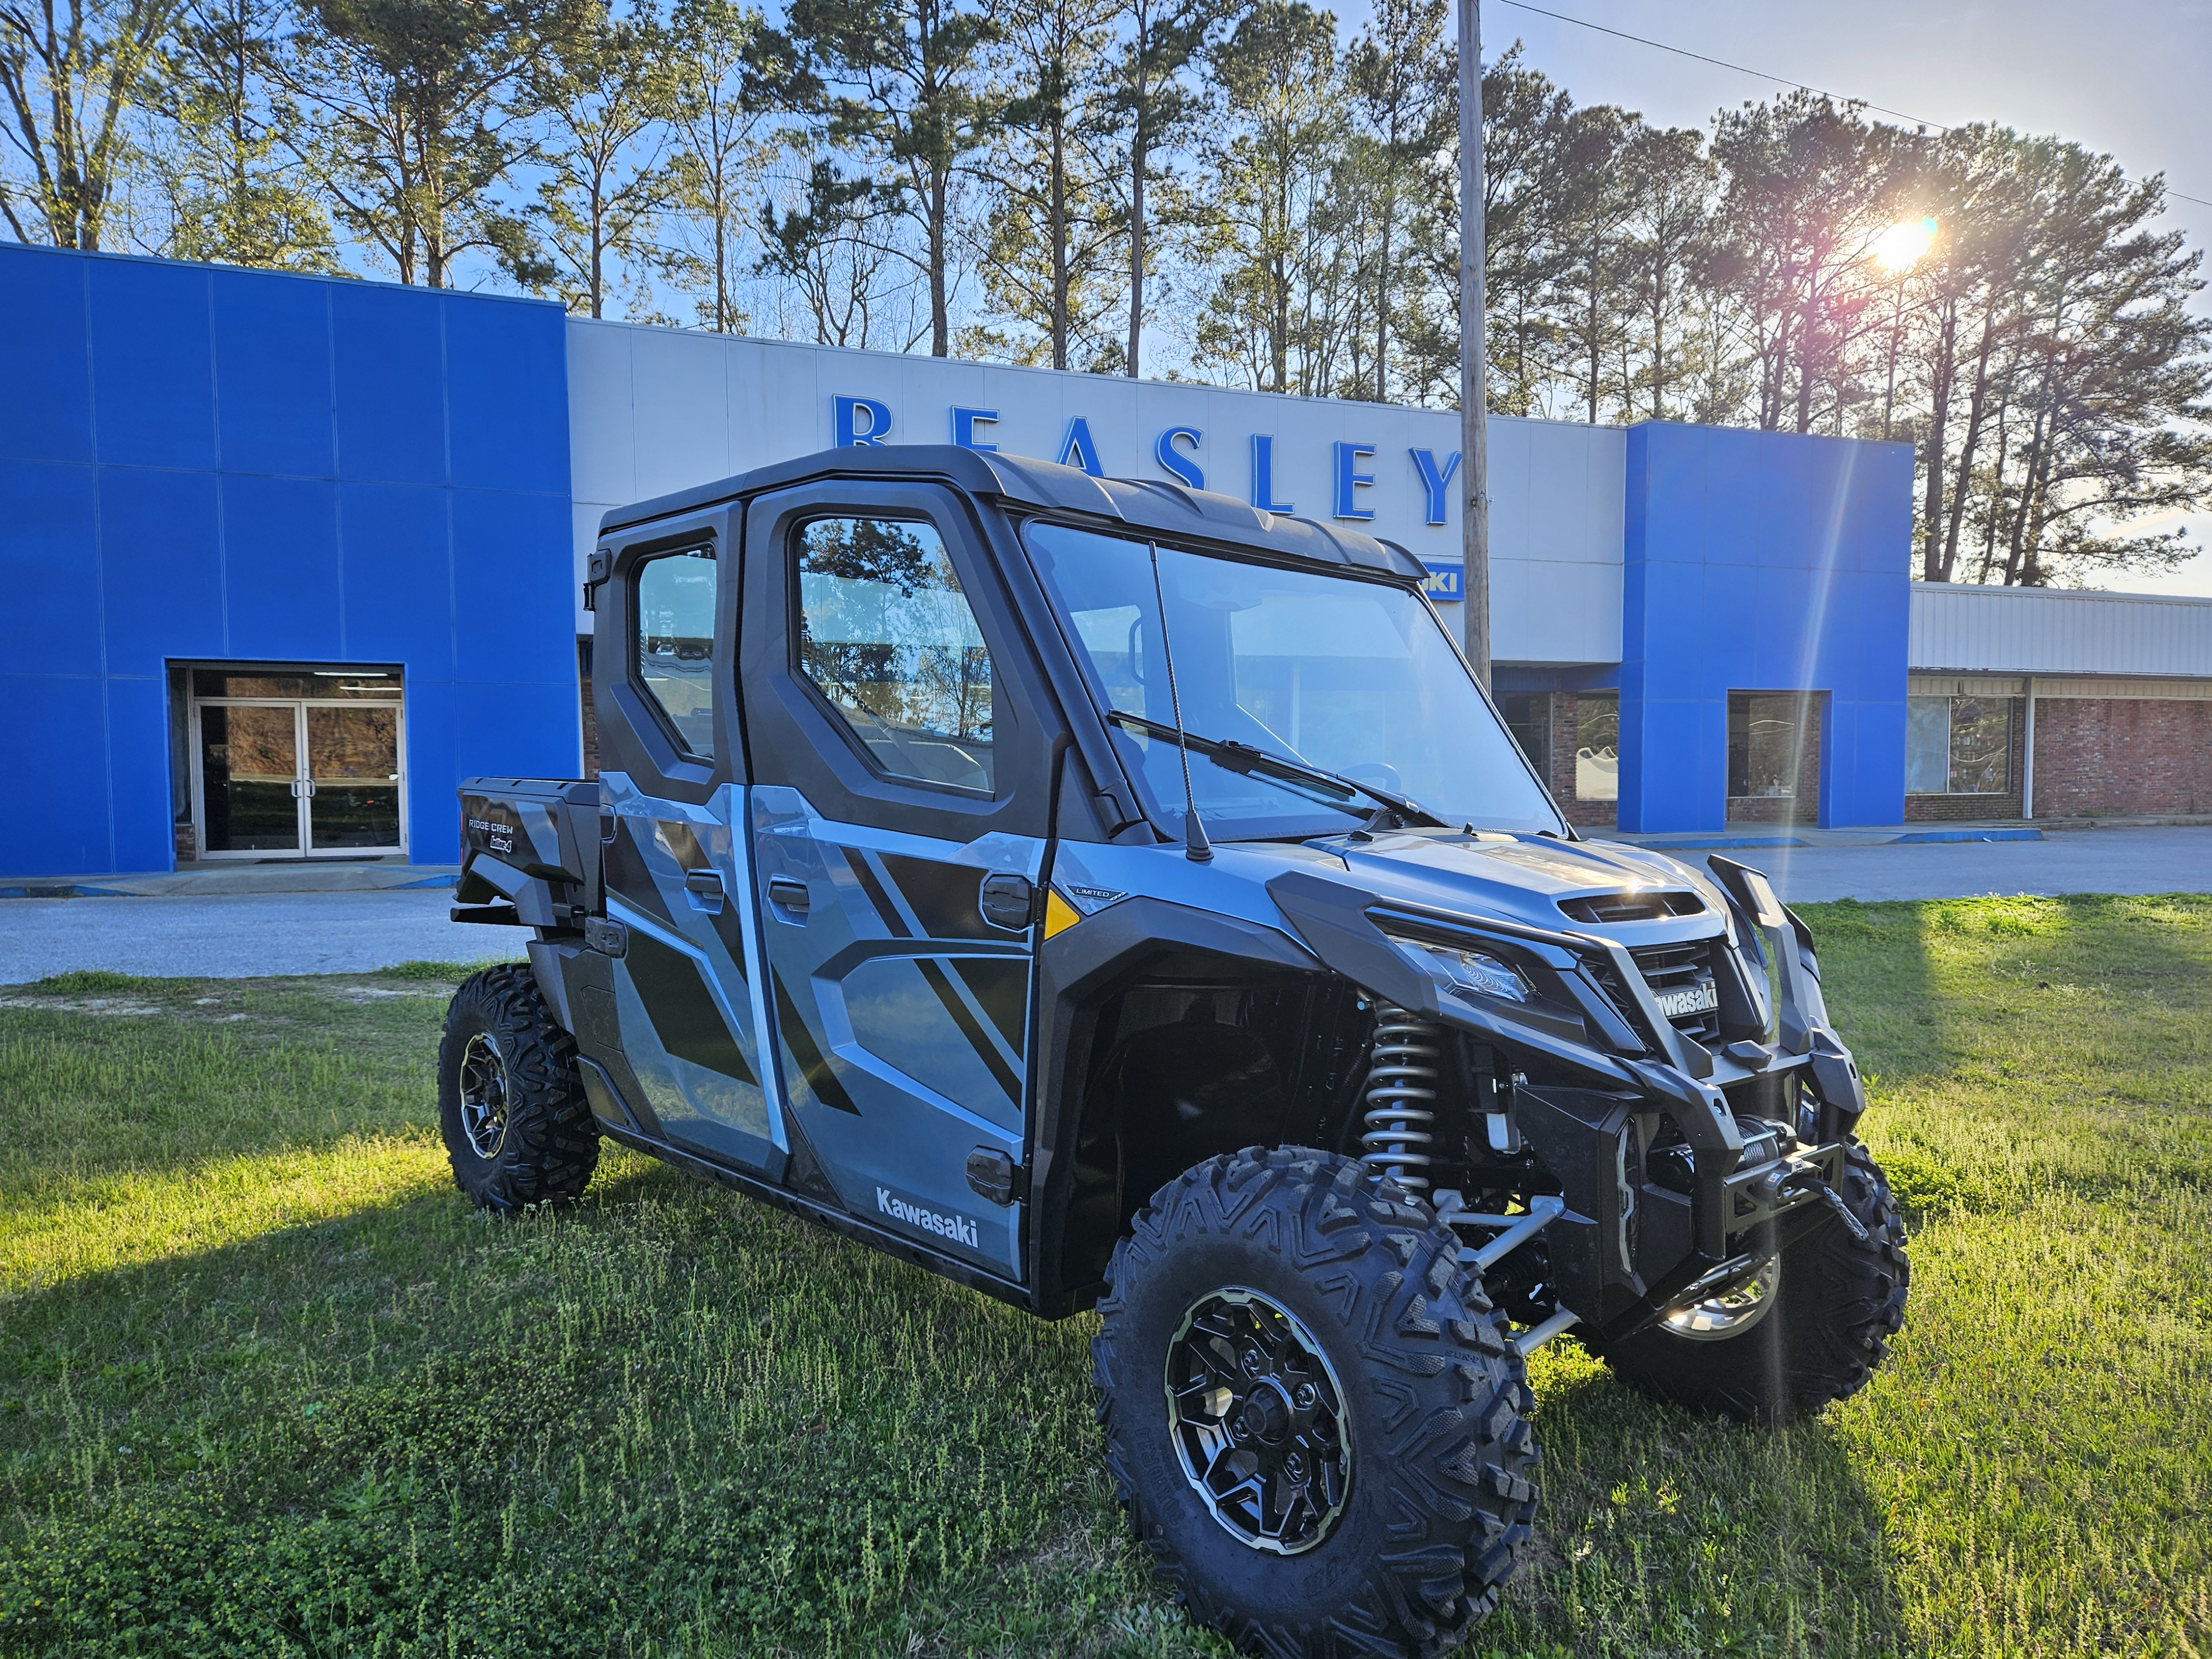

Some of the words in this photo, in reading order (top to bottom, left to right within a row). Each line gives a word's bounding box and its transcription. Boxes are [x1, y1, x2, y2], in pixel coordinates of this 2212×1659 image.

[832, 393, 1462, 525] BEASLEY
[469, 819, 489, 831] RIDGE
[491, 823, 513, 834] CREW
[1076, 888, 1109, 898] LIMITED
[1654, 982, 1718, 1016] awasaki
[876, 1186, 978, 1248] Kawasaki
